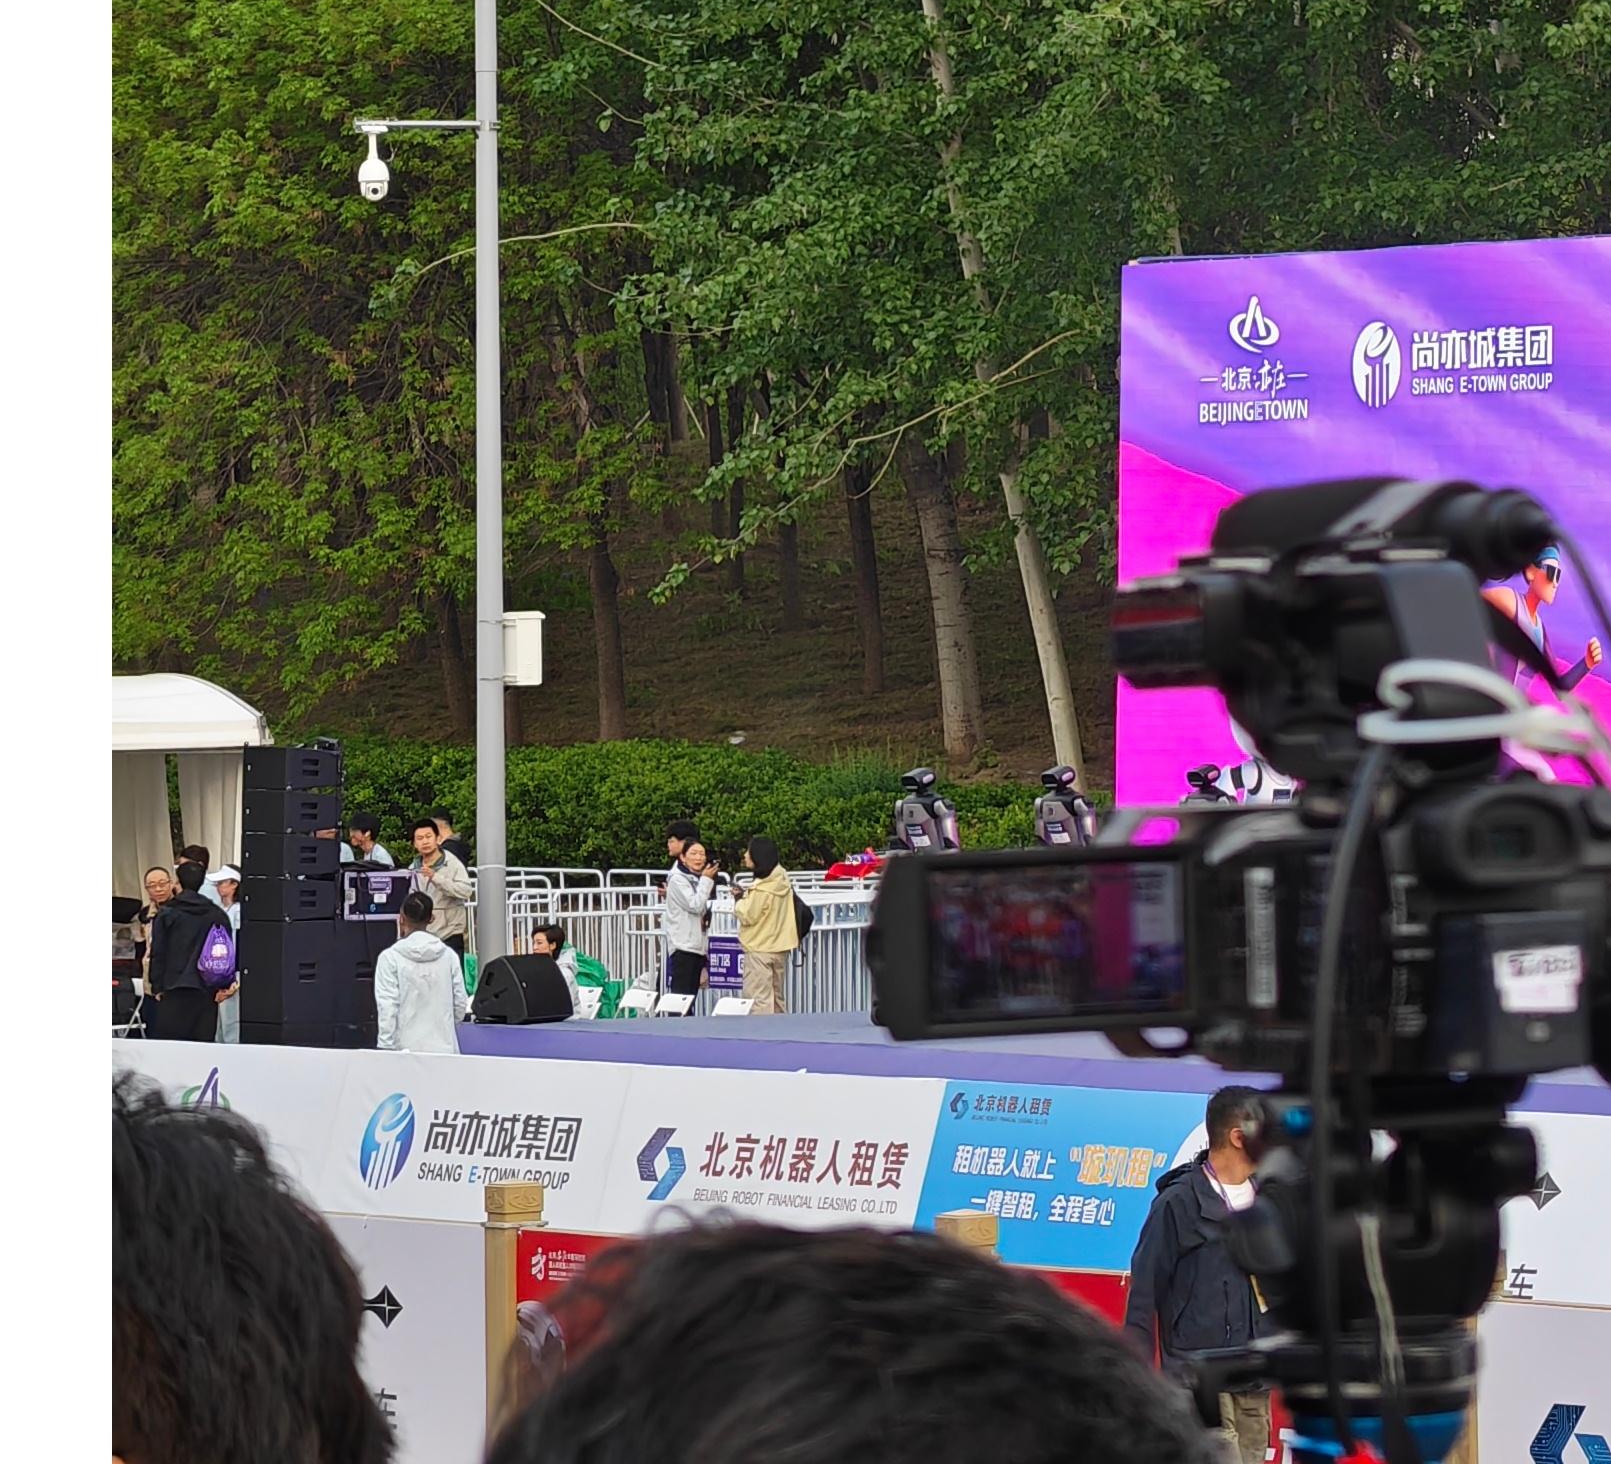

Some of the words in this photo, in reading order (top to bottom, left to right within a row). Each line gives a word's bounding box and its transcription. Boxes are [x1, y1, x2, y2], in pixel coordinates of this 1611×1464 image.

[1411, 325, 1553, 371] 尚亦城集团
[1411, 376, 1454, 395] SHANG
[1459, 374, 1507, 394] E-TOWN
[1510, 372, 1553, 392] GROUP
[423, 1109, 583, 1162] 尚亦城集团
[417, 1162, 463, 1182] SHANG
[699, 1131, 910, 1189] 北京机器人租赁
[952, 1143, 1057, 1181] 租机器人就上
[693, 1188, 728, 1203] BEIJING
[731, 1190, 763, 1206] ROBOT
[767, 1192, 813, 1209] FINANCIAL
[817, 1196, 858, 1213] LEASING
